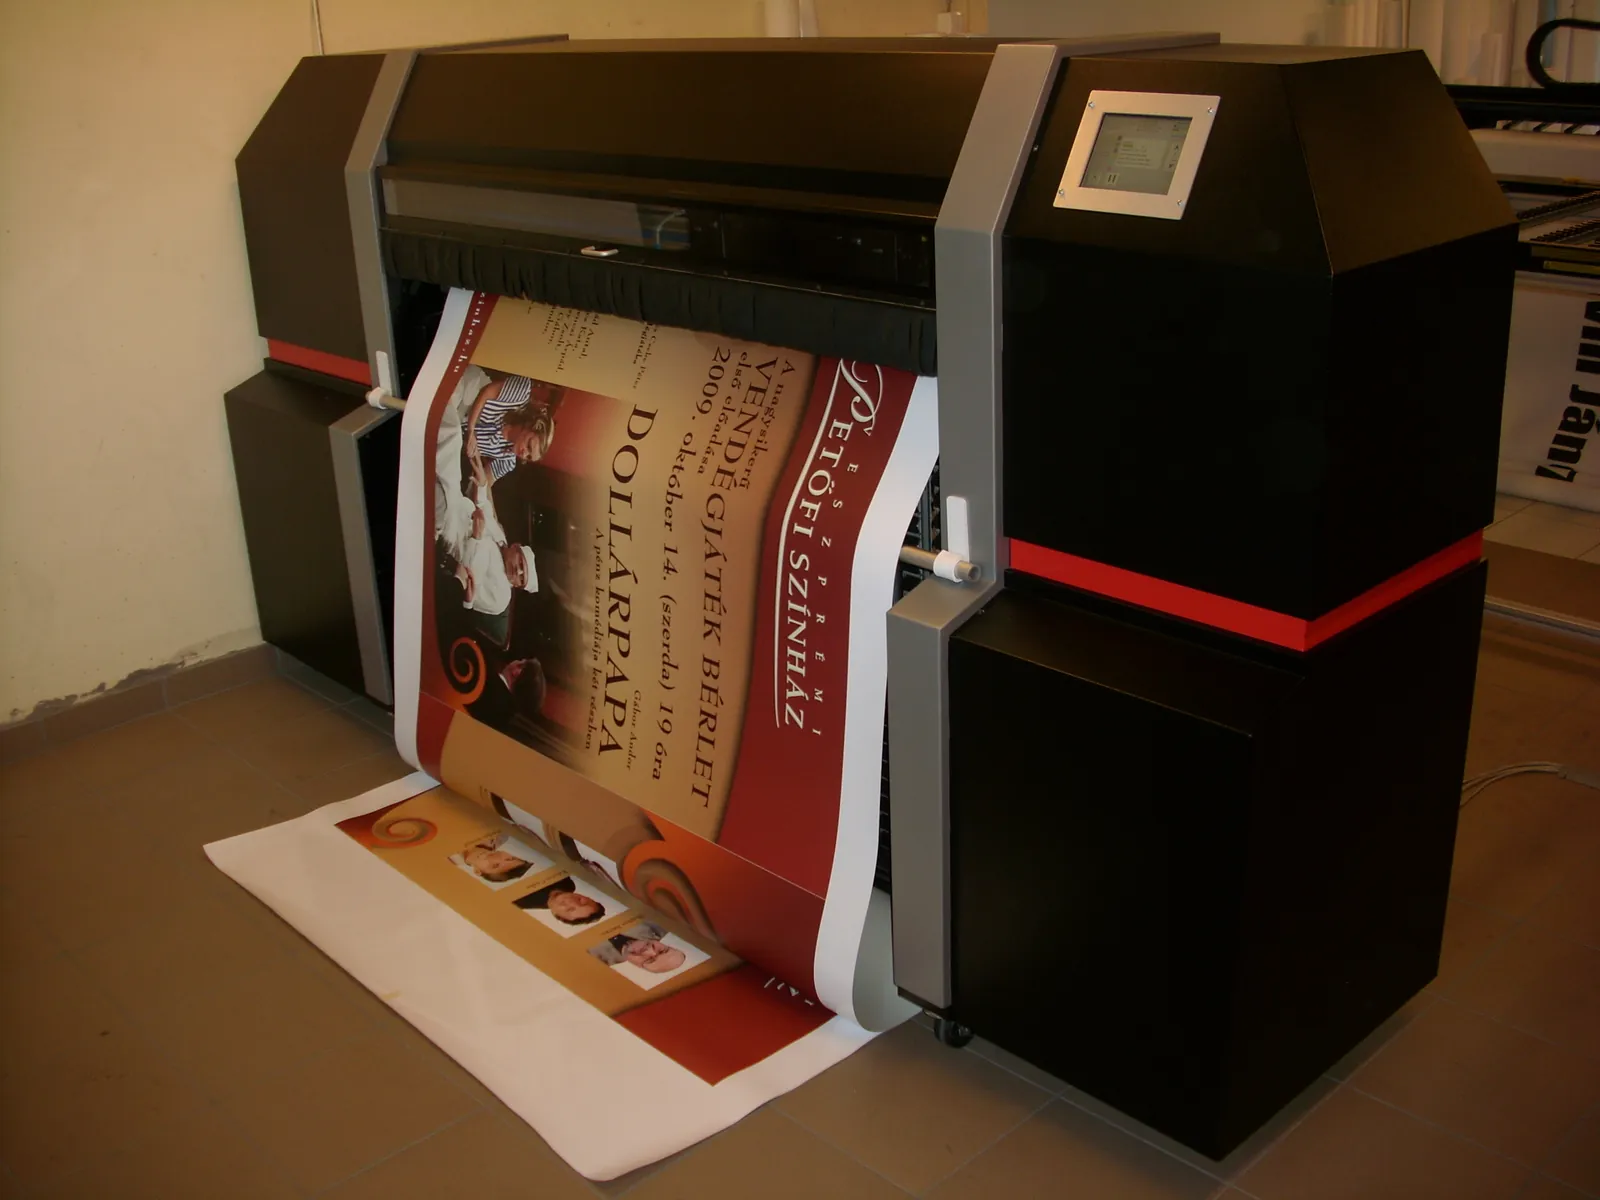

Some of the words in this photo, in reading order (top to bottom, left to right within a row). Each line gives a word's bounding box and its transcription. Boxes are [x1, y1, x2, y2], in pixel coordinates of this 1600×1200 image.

[692, 346, 731, 420] 2009.
[731, 352, 752, 390] első
[781, 360, 795, 376] A
[698, 396, 736, 474] előadása
[739, 384, 784, 489] nagysikerű
[664, 432, 697, 532] október
[700, 357, 779, 646] VENDÉGJÁTÉK
[595, 528, 604, 539] A
[593, 544, 604, 580] pénz
[598, 404, 658, 756] DOLLÁRPAPA
[662, 543, 679, 581] 14.
[591, 586, 605, 661] komédiája
[658, 594, 679, 690] (szerda)
[785, 550, 811, 729] SZÍNHÁZ
[591, 667, 602, 690] két
[585, 695, 598, 749] részben
[631, 689, 642, 728] Gábor
[656, 702, 674, 735] 19
[691, 653, 724, 808] BÉRLET
[626, 731, 638, 771] Andor
[652, 742, 668, 780] óra
